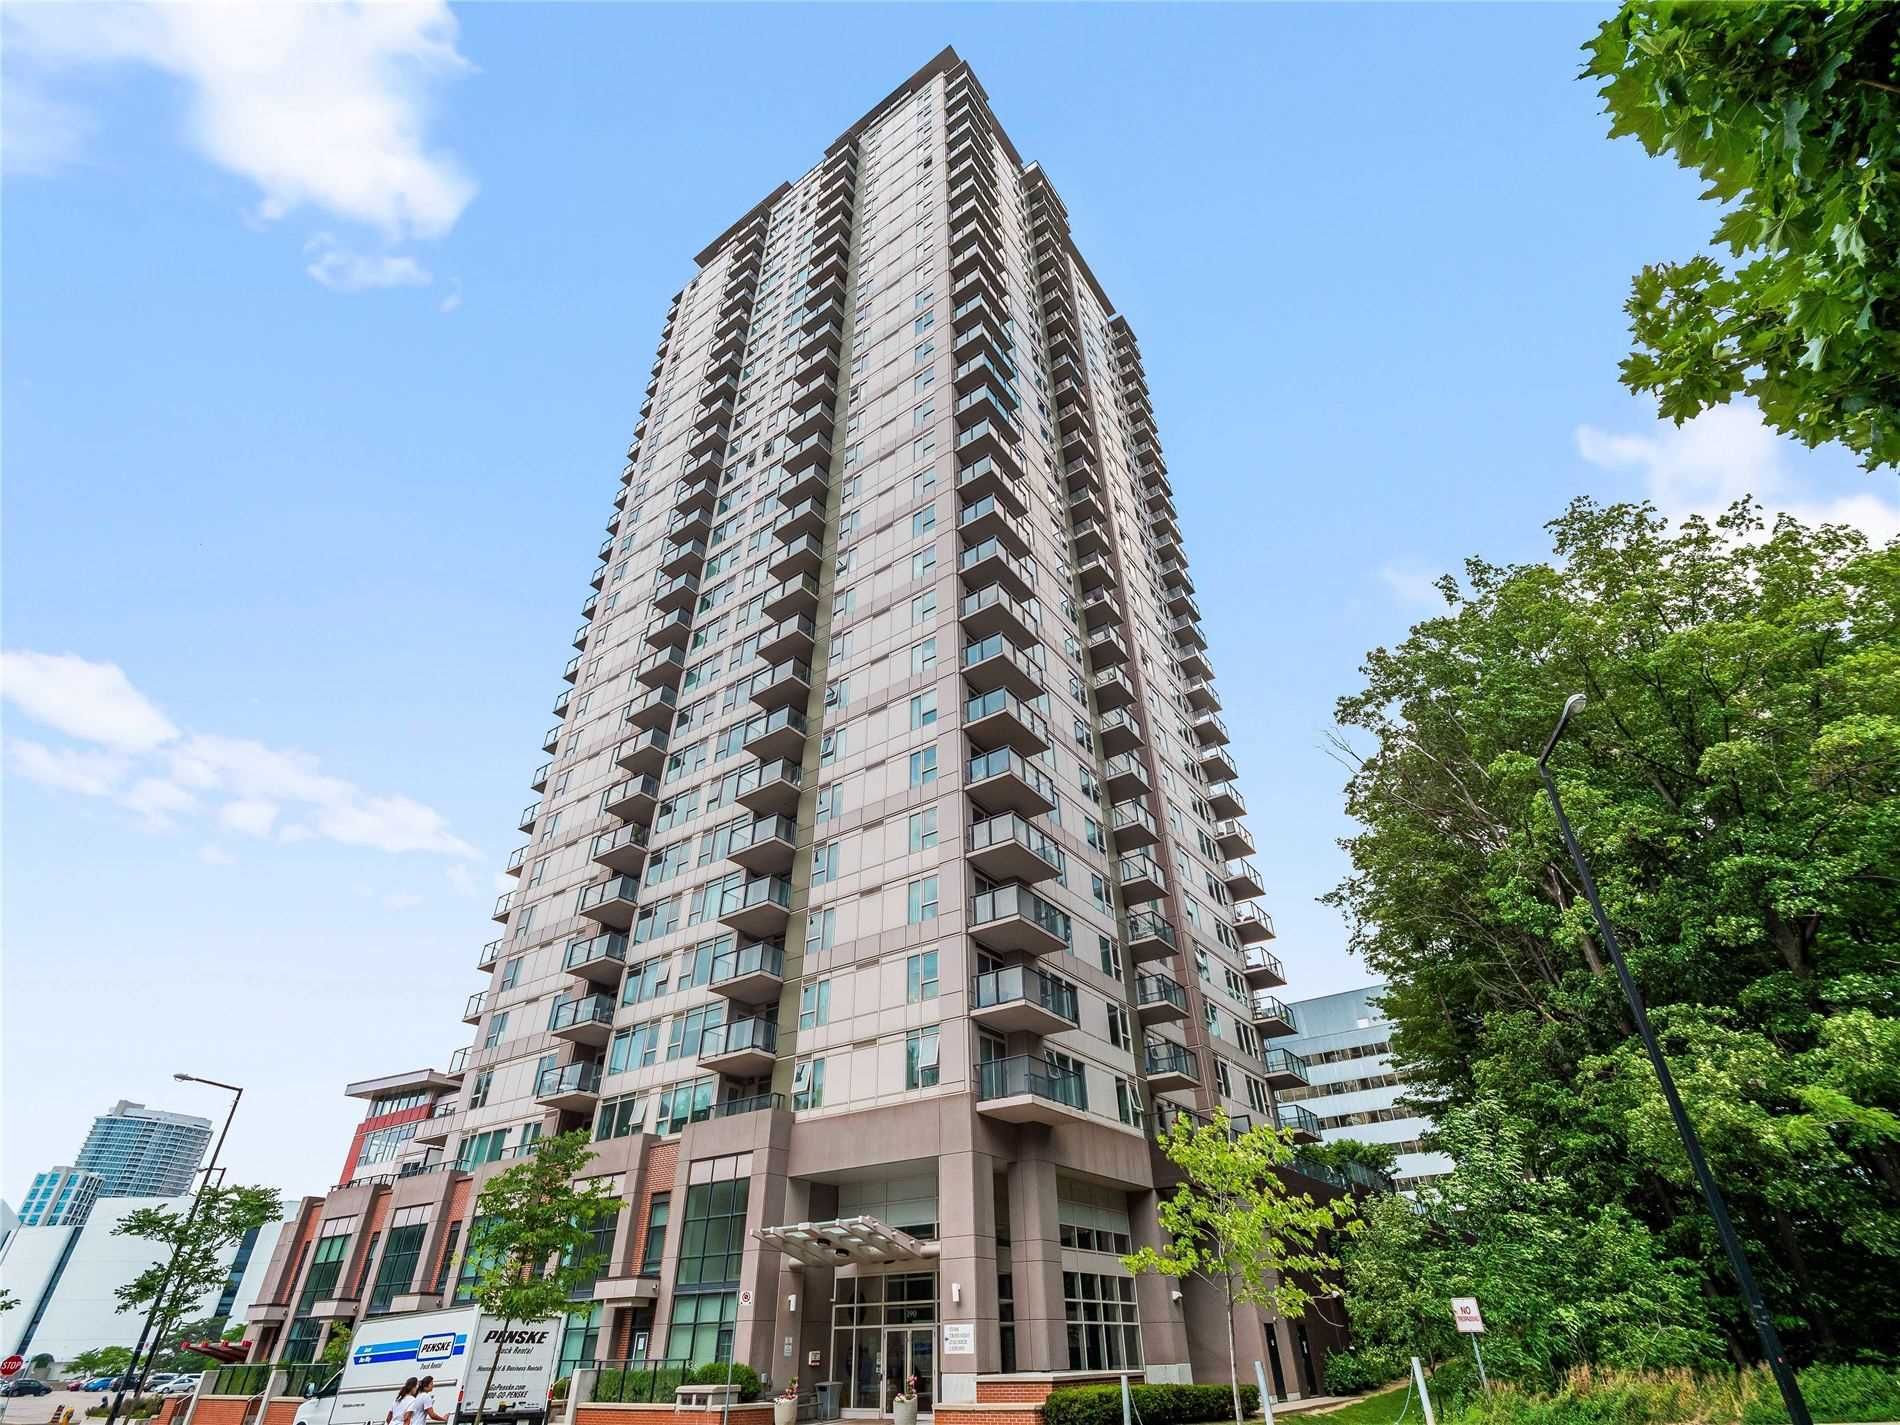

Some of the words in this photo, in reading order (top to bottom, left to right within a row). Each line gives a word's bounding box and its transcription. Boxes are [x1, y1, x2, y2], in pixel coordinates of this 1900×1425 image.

[1460, 1305, 1471, 1315] NO
[483, 1330, 549, 1344] PENSKE
[421, 1341, 451, 1353] PENSKE
[513, 1346, 534, 1355] Rental
[2, 1360, 21, 1370] STOP
